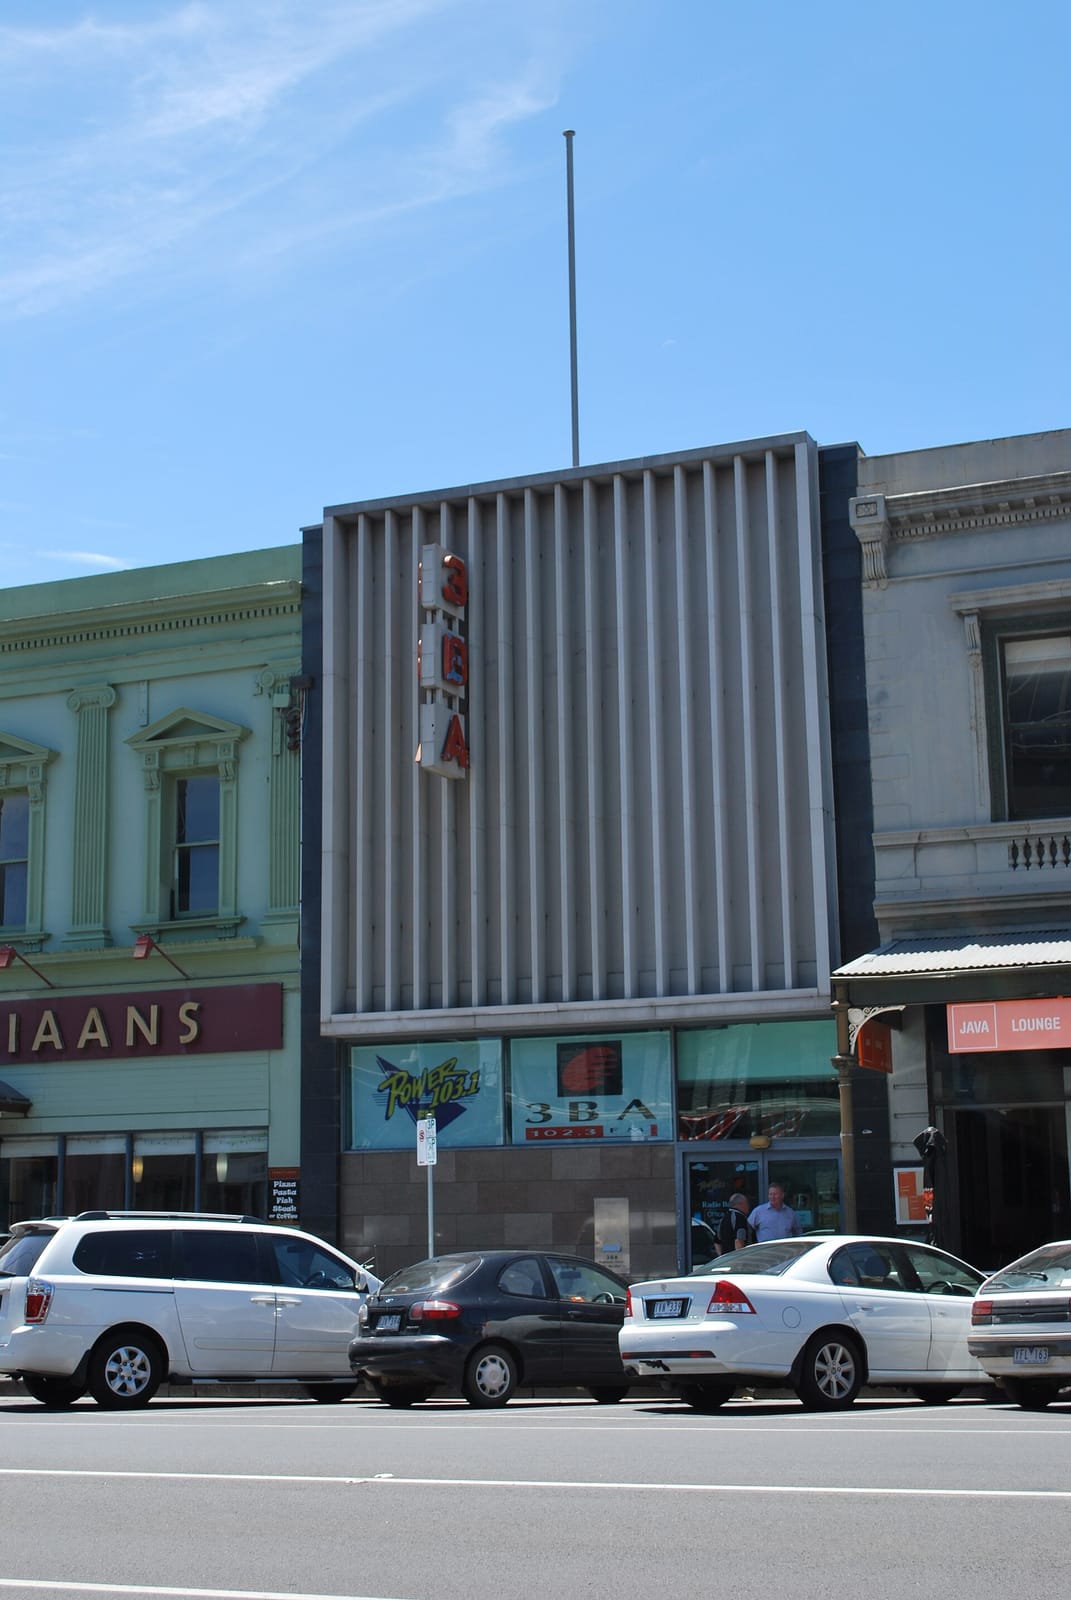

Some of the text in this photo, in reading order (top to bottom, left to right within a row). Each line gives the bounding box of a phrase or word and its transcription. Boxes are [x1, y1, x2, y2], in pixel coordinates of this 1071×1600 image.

[8, 1002, 199, 1053] IAANS
[960, 1016, 1062, 1034] JAVA LOUNGE
[429, 1069, 480, 1109] 103.1
[525, 1099, 657, 1123] 3BA
[527, 1126, 597, 1138] 102.3
[272, 1188, 297, 1196] Pasta
[276, 1196, 293, 1204] Fish
